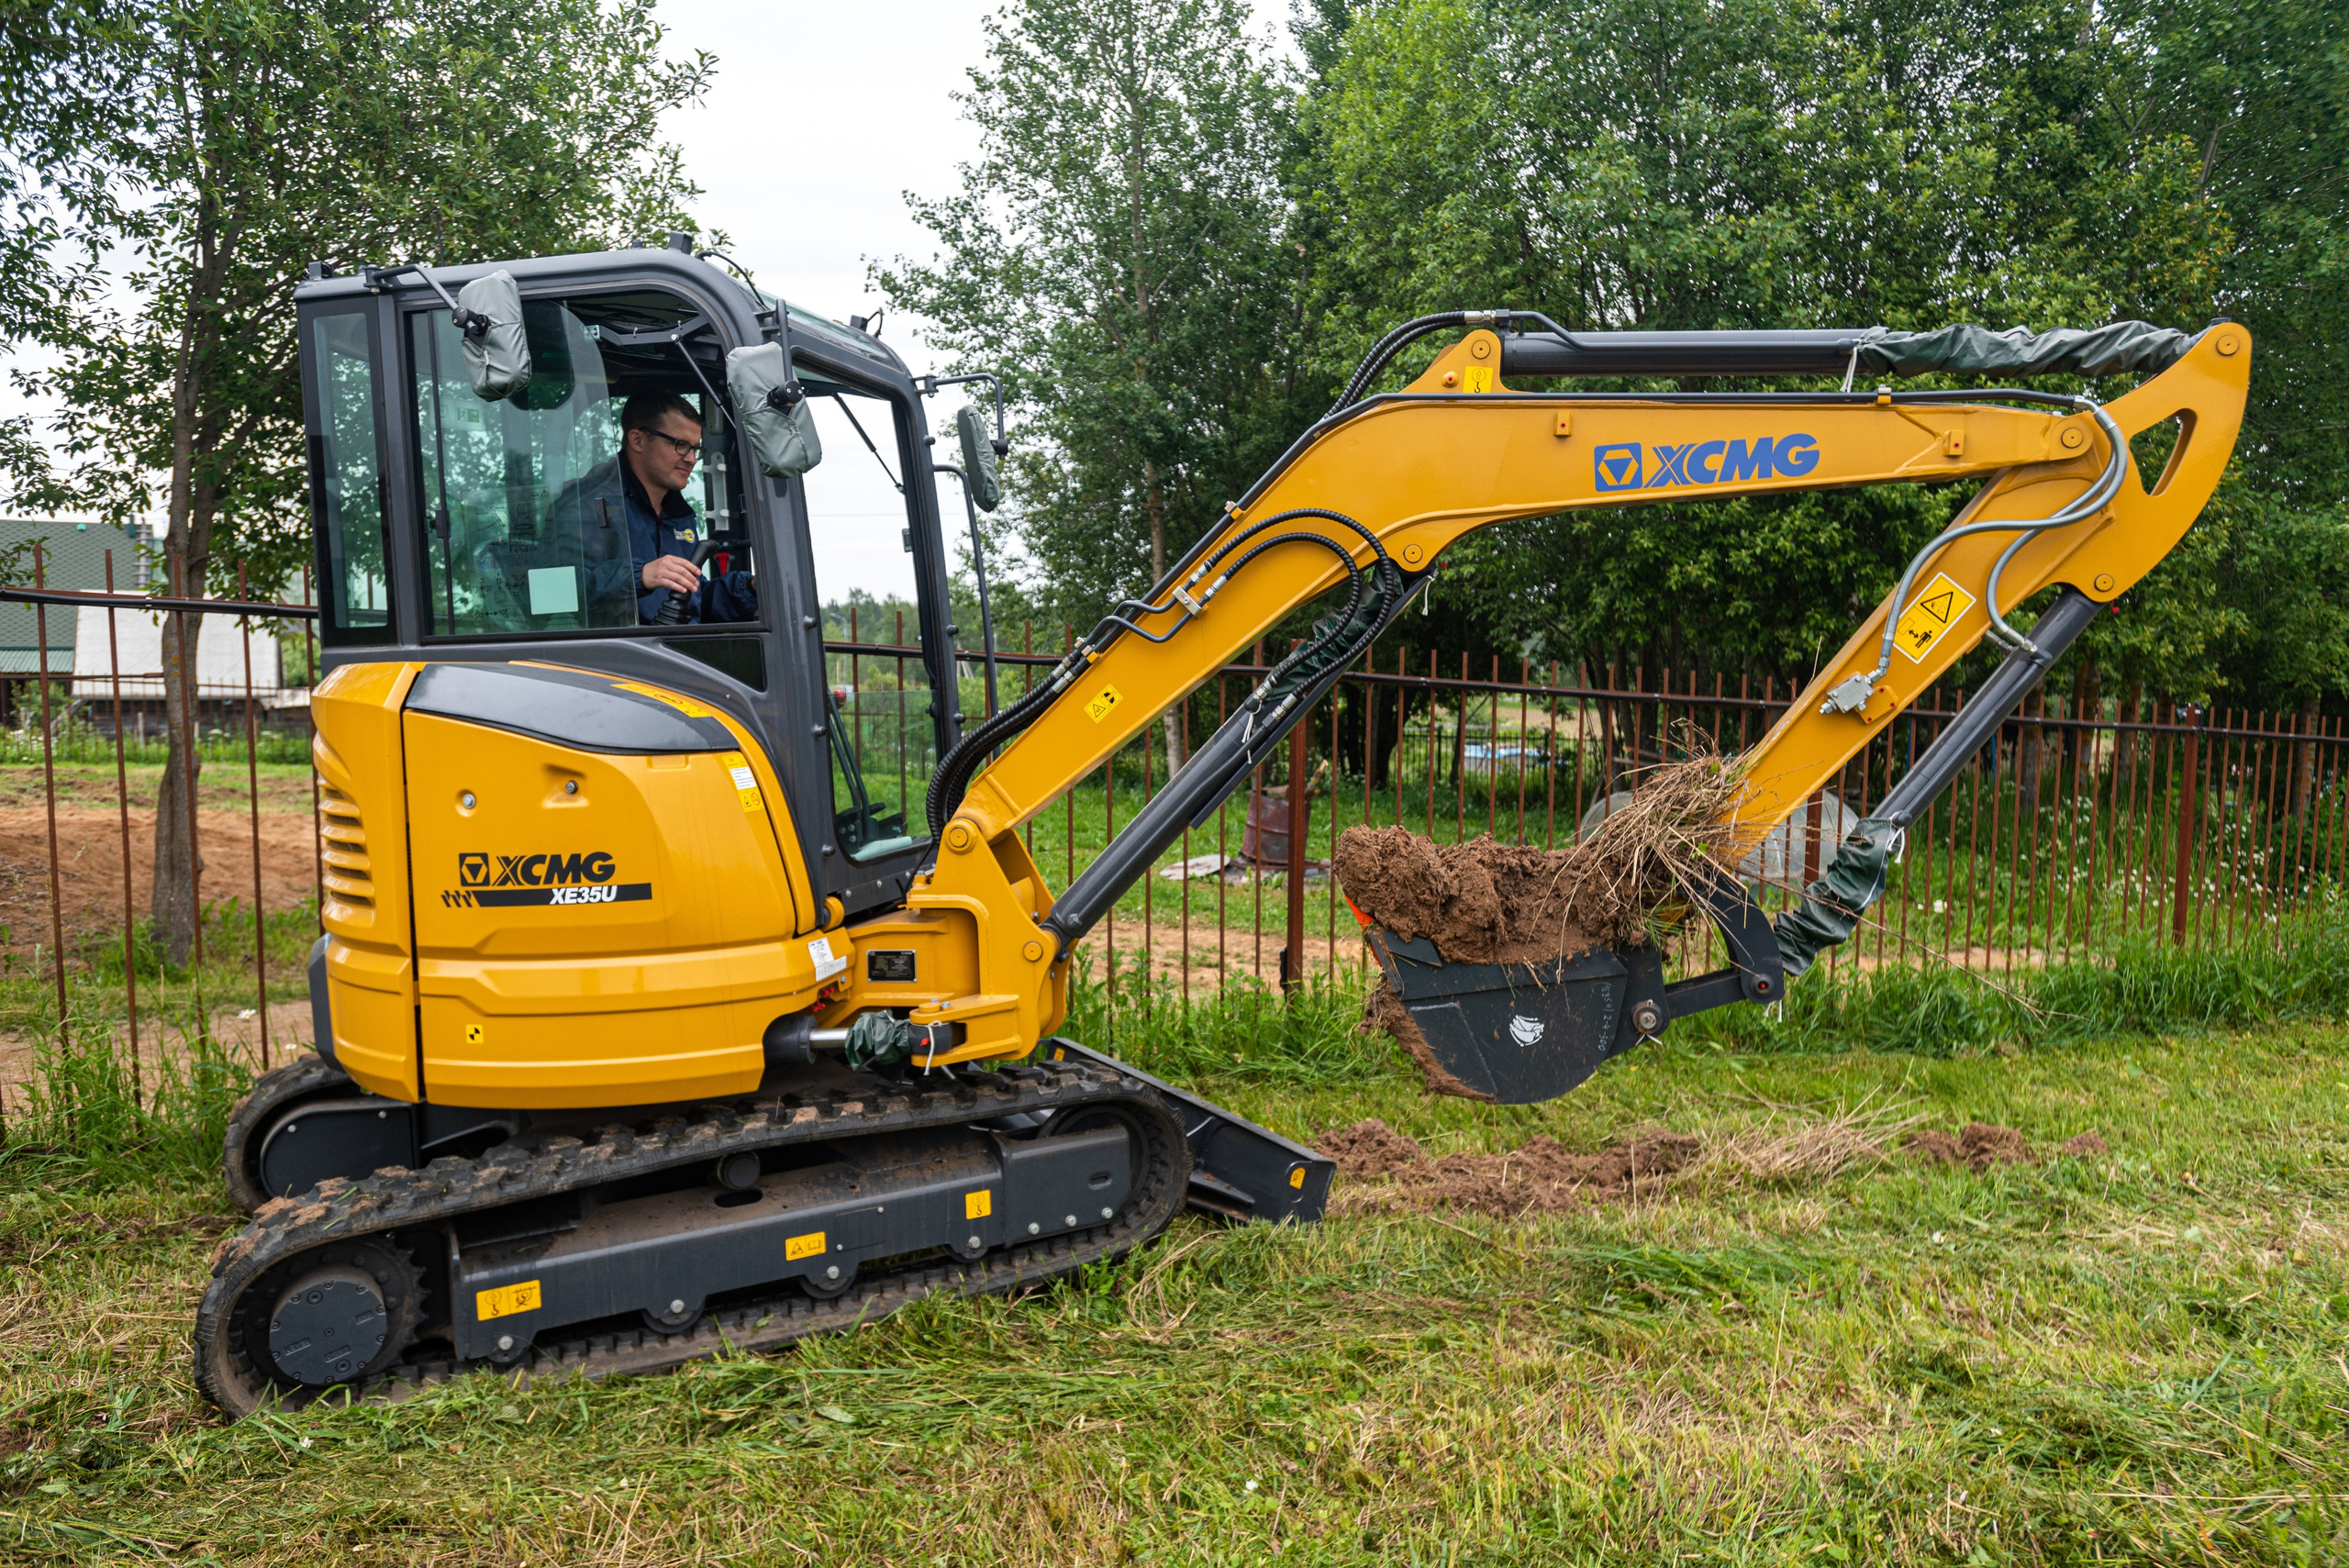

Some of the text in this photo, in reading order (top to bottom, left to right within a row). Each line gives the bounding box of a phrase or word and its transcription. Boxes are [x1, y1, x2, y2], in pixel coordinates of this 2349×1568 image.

[1643, 433, 1820, 488] XCMG
[491, 851, 616, 886] XCMG
[550, 884, 618, 905] XE35U
